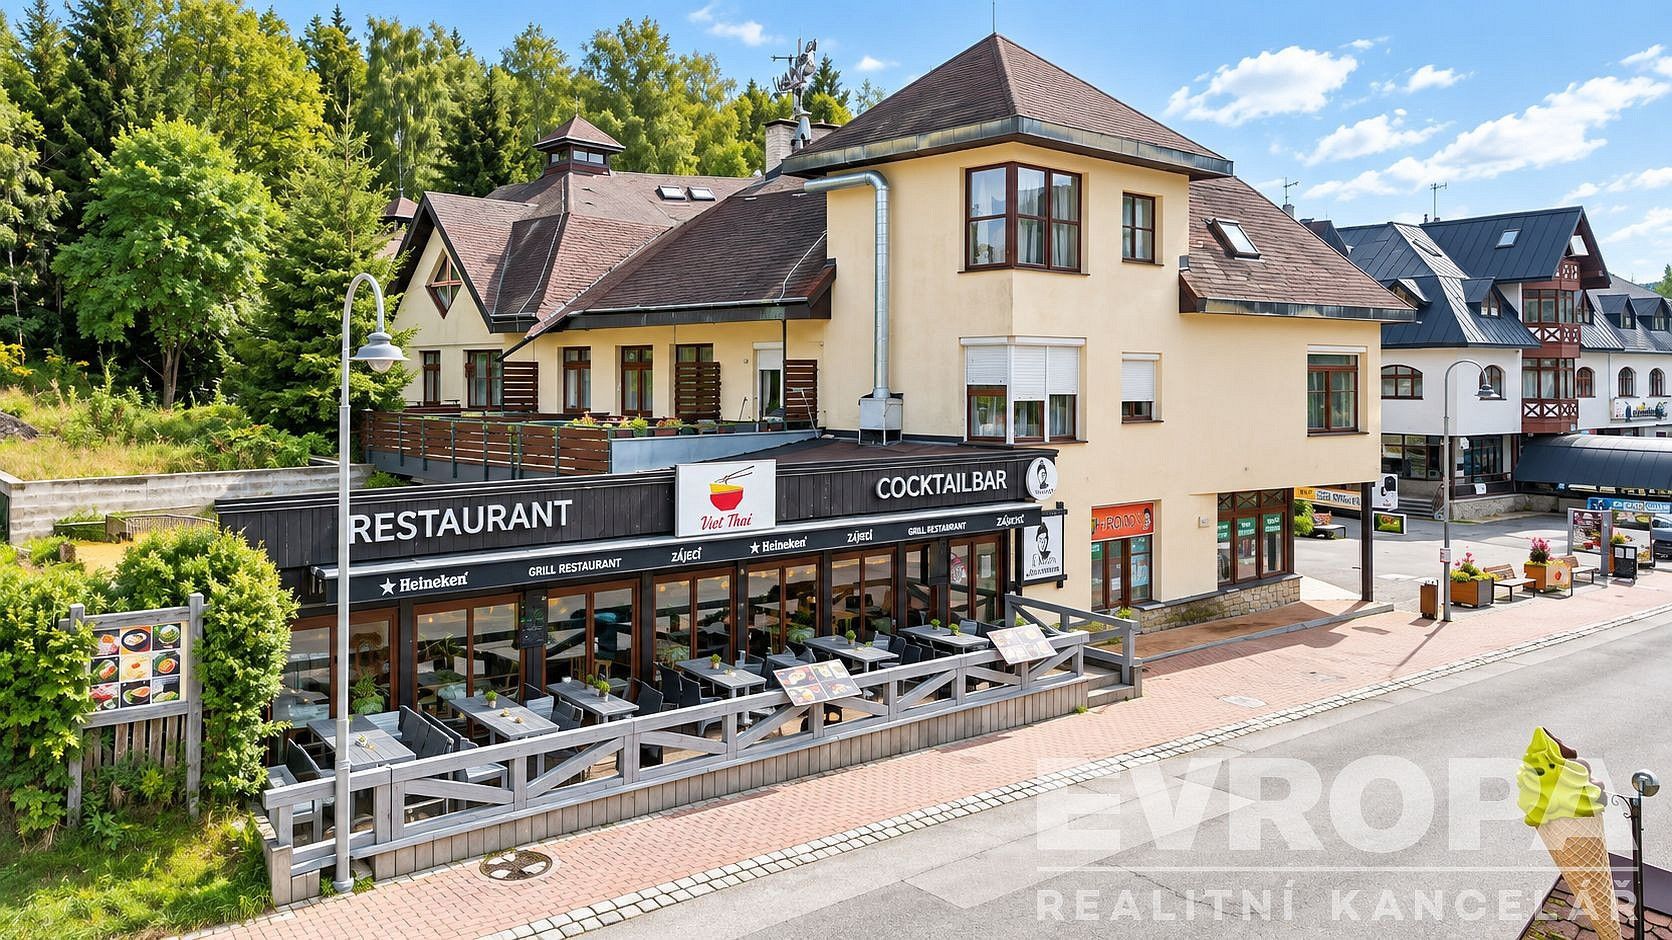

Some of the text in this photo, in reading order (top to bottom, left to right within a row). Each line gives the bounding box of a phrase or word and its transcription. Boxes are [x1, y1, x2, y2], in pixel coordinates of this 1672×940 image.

[876, 470, 1007, 499] COCKTAILBAR
[349, 500, 573, 544] RESTAURANT
[700, 513, 753, 530] Viet Thai
[762, 536, 808, 552] Heineken
[528, 557, 623, 577] GRILL RESTAURANT
[399, 572, 469, 593] Heineken
